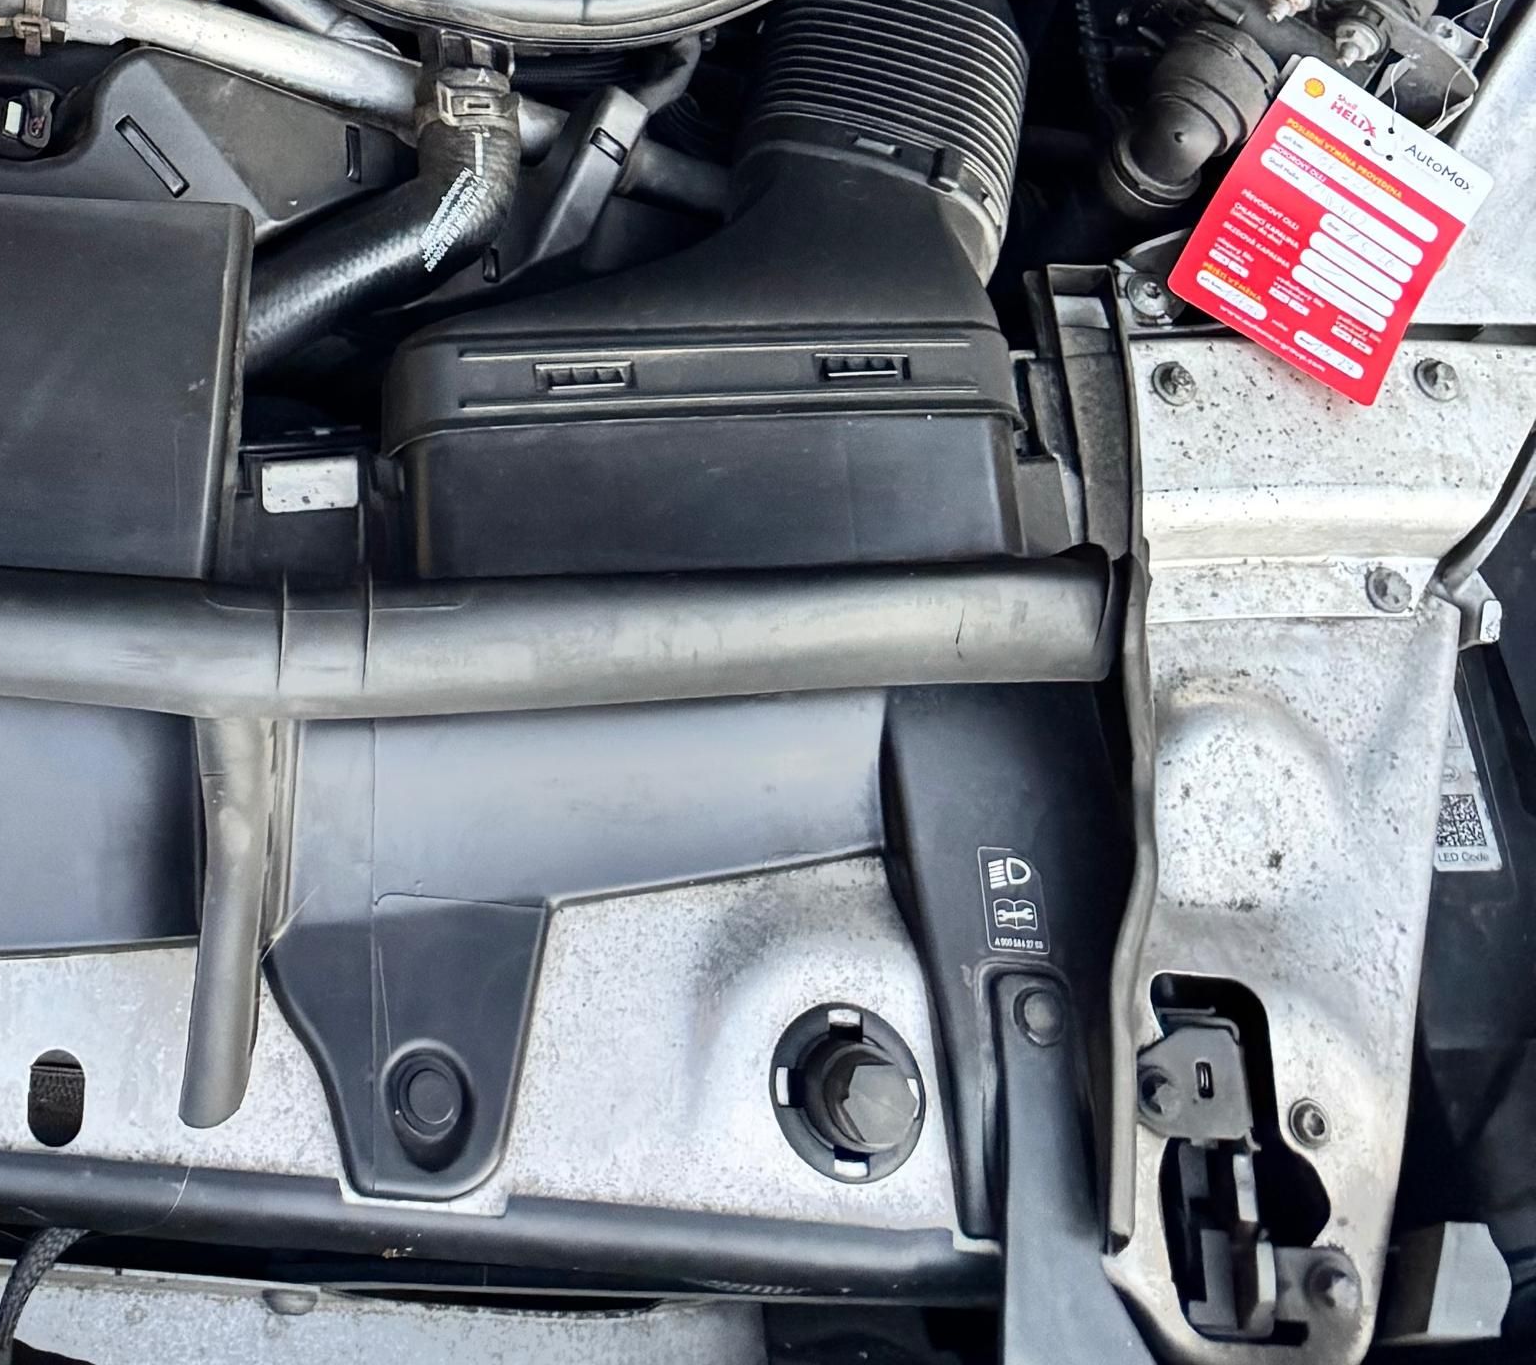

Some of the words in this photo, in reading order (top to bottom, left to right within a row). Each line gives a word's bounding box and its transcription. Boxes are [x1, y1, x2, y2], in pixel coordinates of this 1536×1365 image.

[1329, 97, 1381, 138] HELIX
[1438, 852, 1459, 863] LED
[1462, 852, 1490, 862] Code
